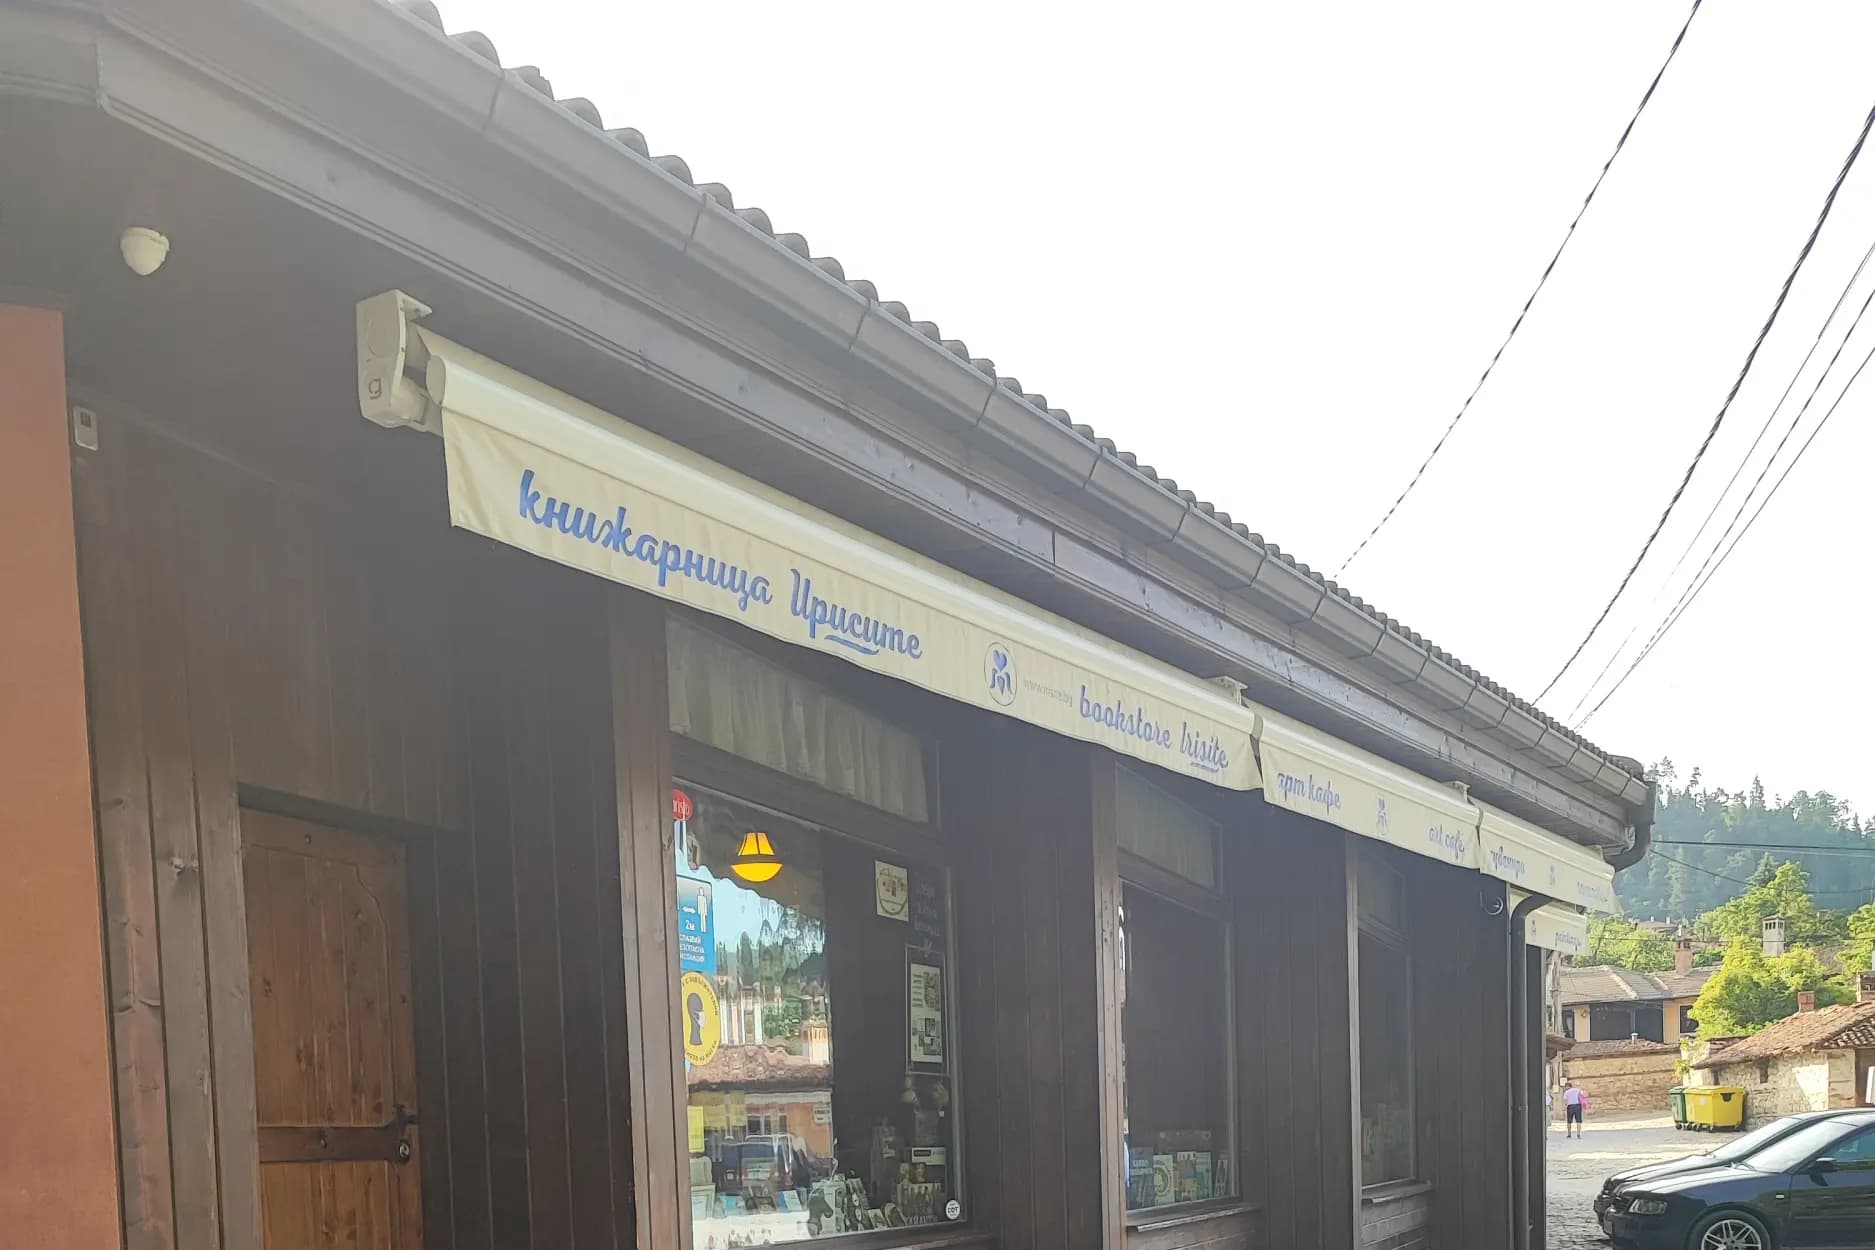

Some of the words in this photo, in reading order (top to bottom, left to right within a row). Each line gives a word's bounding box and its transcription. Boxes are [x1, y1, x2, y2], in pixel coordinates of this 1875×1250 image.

[519, 469, 773, 610] книжарница
[790, 568, 922, 660] Ирисите
[1079, 684, 1173, 750] bookstore
[1179, 721, 1229, 770] Irisite
